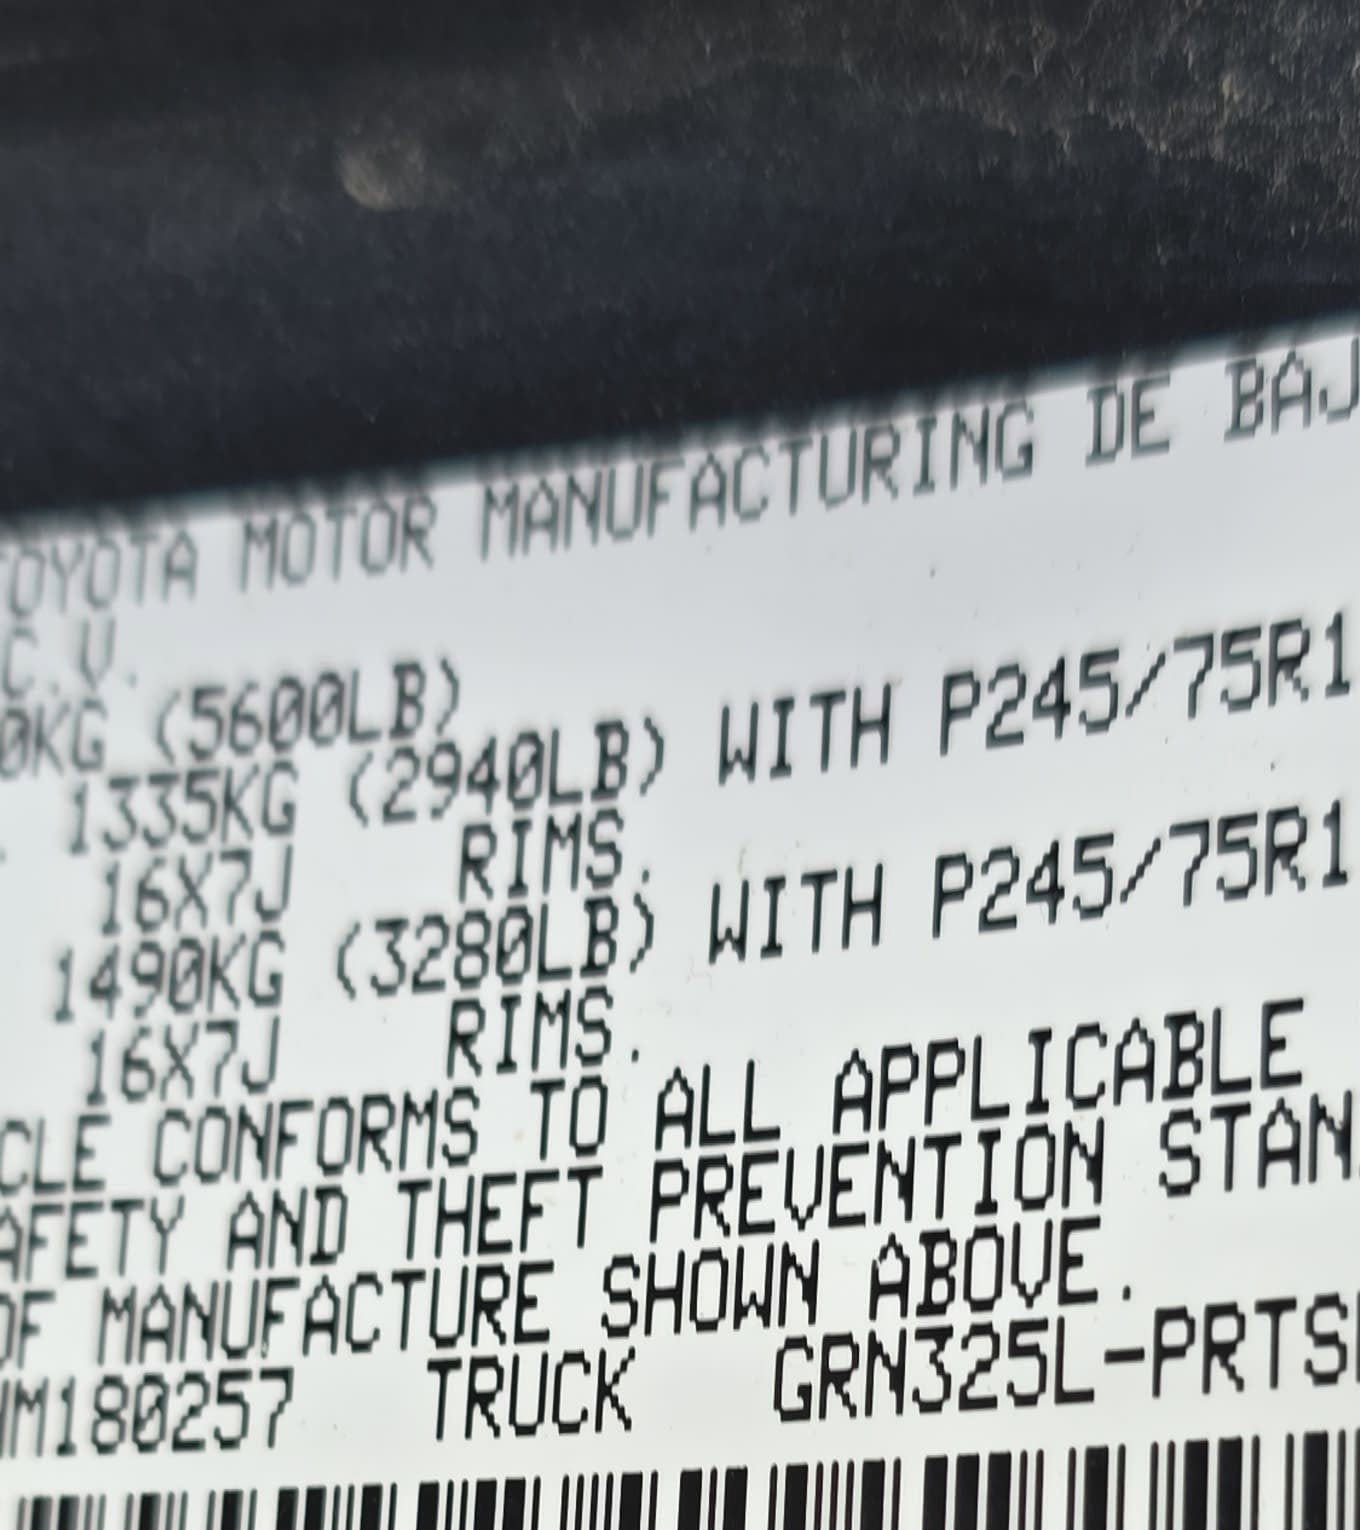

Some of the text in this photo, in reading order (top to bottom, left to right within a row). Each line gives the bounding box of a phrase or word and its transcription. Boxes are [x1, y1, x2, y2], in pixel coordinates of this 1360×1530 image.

[240, 496, 436, 591] MOTOR
[483, 403, 1035, 559] MANUFACTURING
[1086, 374, 1170, 466] DE
[70, 760, 295, 855] 1335KG
[348, 716, 663, 827] (2940LB)
[718, 682, 892, 787] WITH
[156, 658, 460, 765] (5600LB)
[54, 929, 285, 1023] 1490KG
[337, 893, 654, 1000] (3280LB)
[710, 864, 884, 963] WITH
[102, 809, 649, 936] 16X7J RIMS.
[88, 987, 640, 1104] 16X7J RIMS.
[154, 1086, 480, 1187] CONFORMS
[531, 1075, 609, 1159] TO
[656, 1059, 781, 1153] ALL
[836, 997, 1304, 1135] APPLICABLE
[227, 1185, 348, 1271] AND
[399, 1166, 603, 1261] THEFT
[650, 1117, 1104, 1244] PREVENTION
[98, 1262, 554, 1366] MANUFACTURE
[601, 1240, 820, 1339] SHOWN
[869, 1216, 1132, 1321] ABOVE.
[427, 1348, 637, 1441] TRUCK
